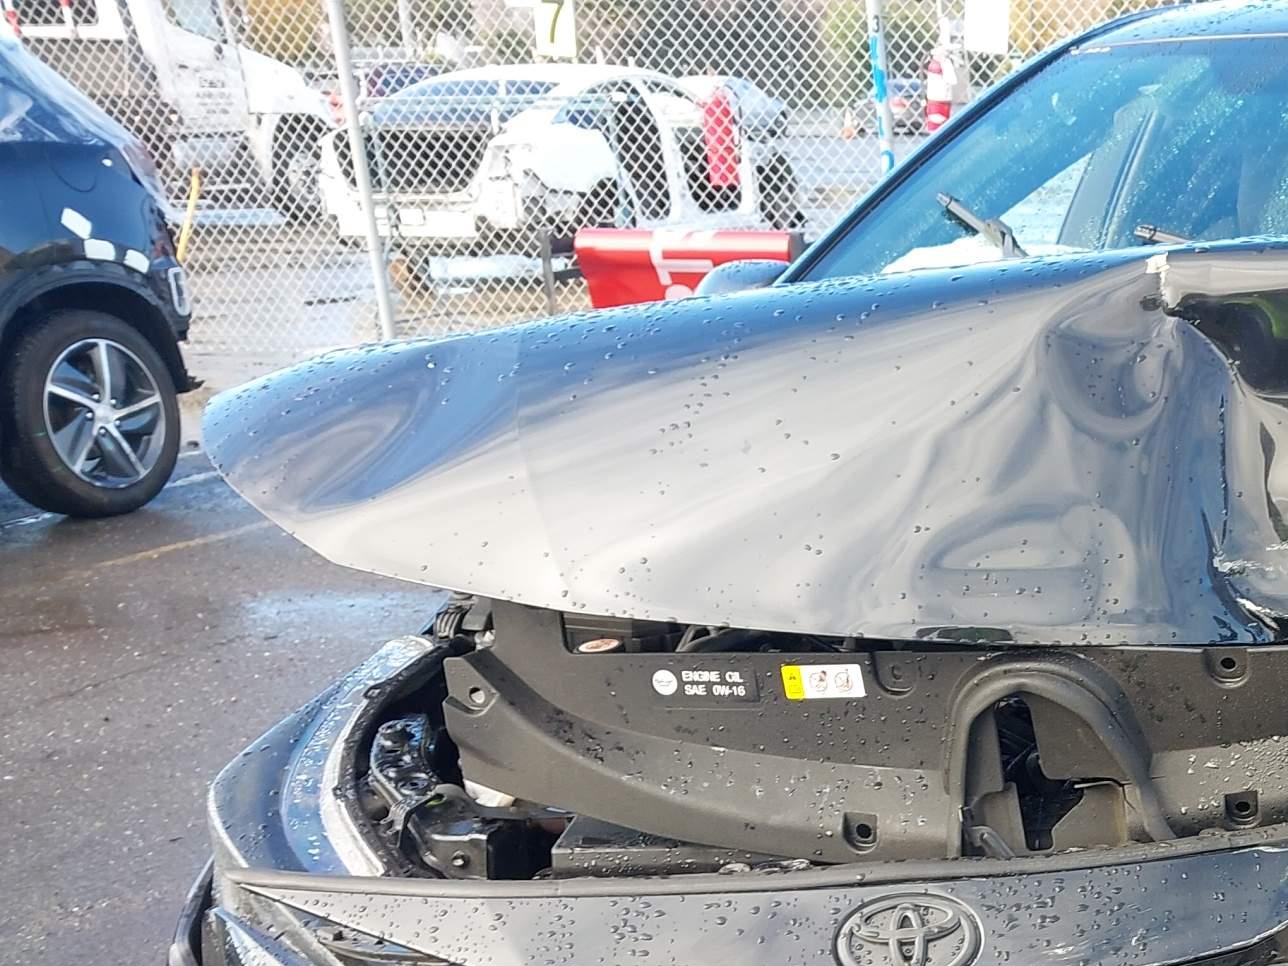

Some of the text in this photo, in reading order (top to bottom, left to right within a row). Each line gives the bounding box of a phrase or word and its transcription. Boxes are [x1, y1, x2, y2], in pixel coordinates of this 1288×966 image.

[540, 0, 564, 44] 7
[681, 670, 744, 683] ENGINE OIL
[684, 684, 746, 697] SAE 0W-16
